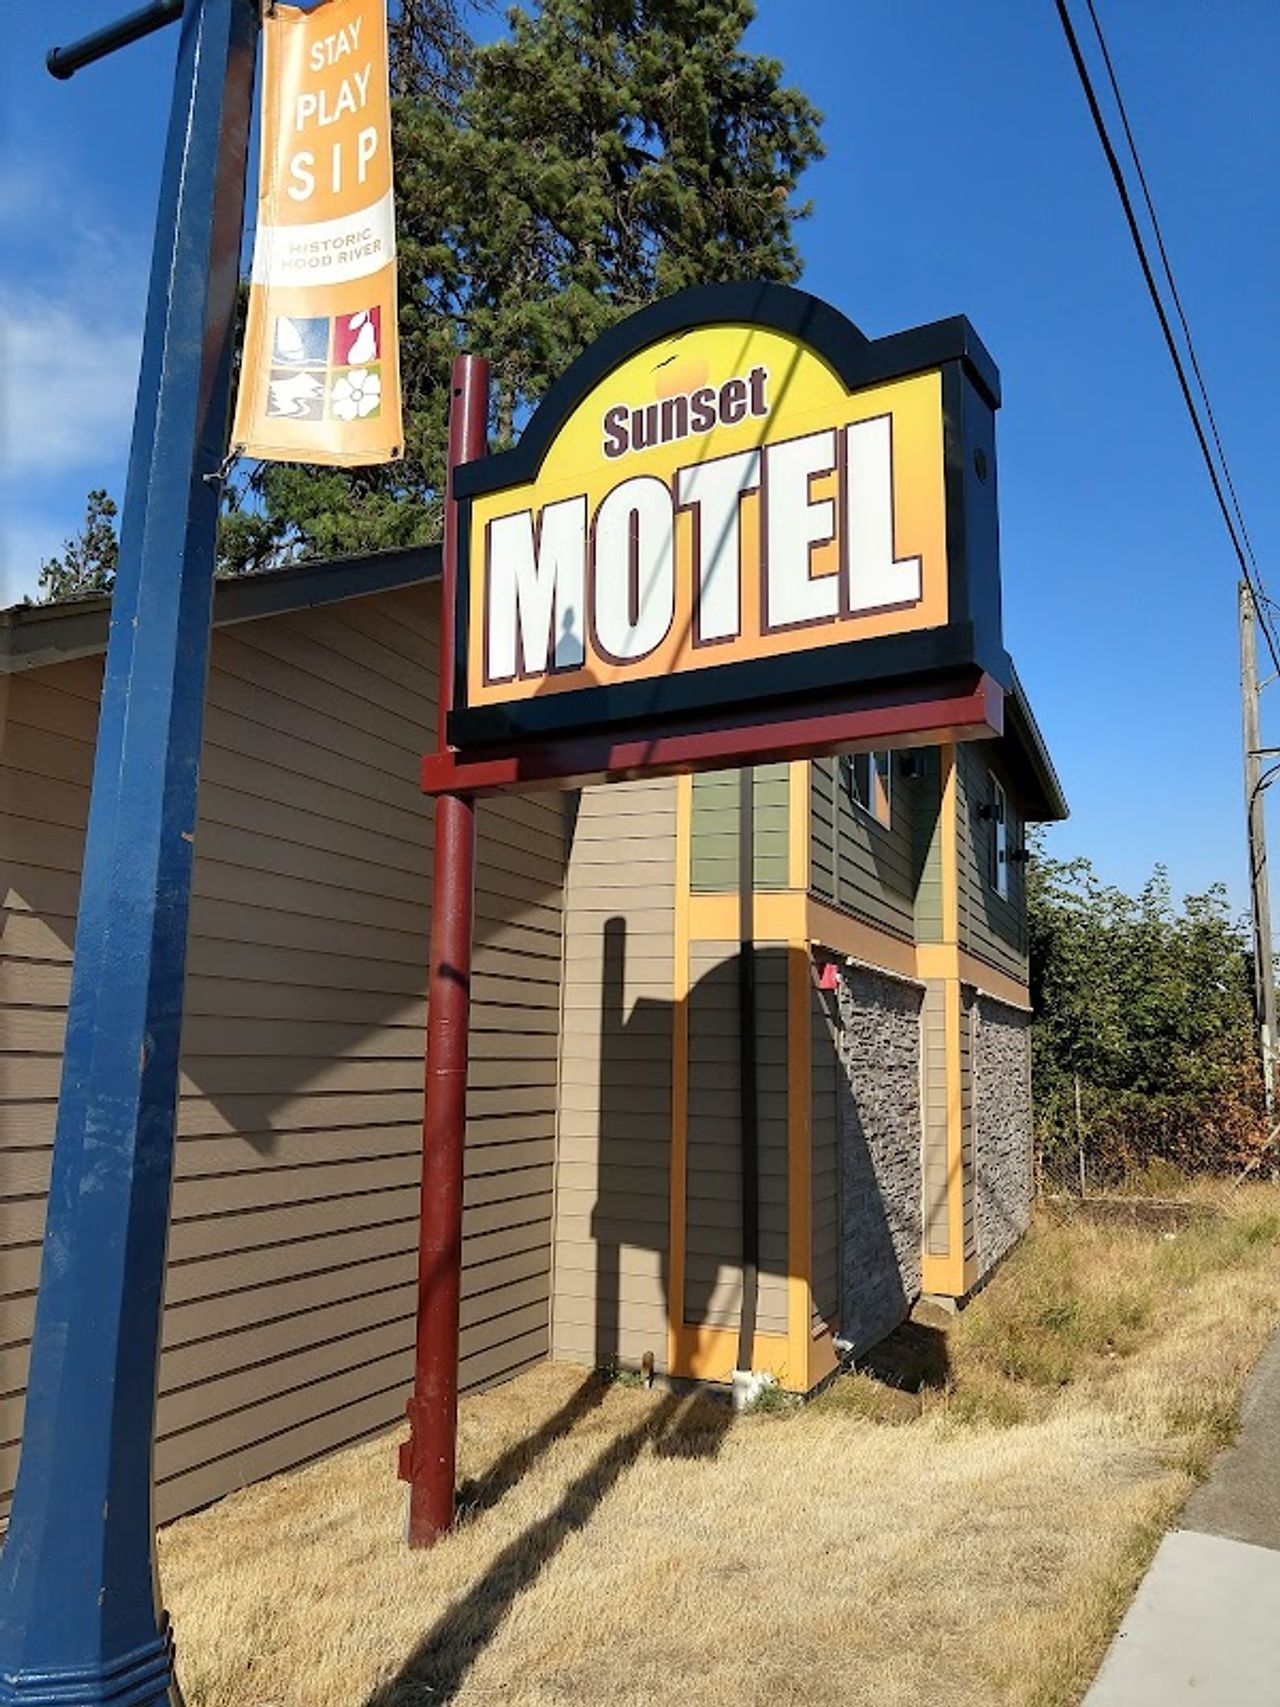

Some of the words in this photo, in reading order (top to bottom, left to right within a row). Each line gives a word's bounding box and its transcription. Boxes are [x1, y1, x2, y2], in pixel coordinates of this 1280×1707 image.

[310, 16, 363, 71] STAY
[296, 64, 372, 133] PLAY
[281, 253, 333, 271] HOOD
[337, 240, 382, 265] RIVER
[289, 228, 372, 255] HISTORIC
[603, 366, 768, 458] Sunset
[484, 412, 923, 688] MOTEL
